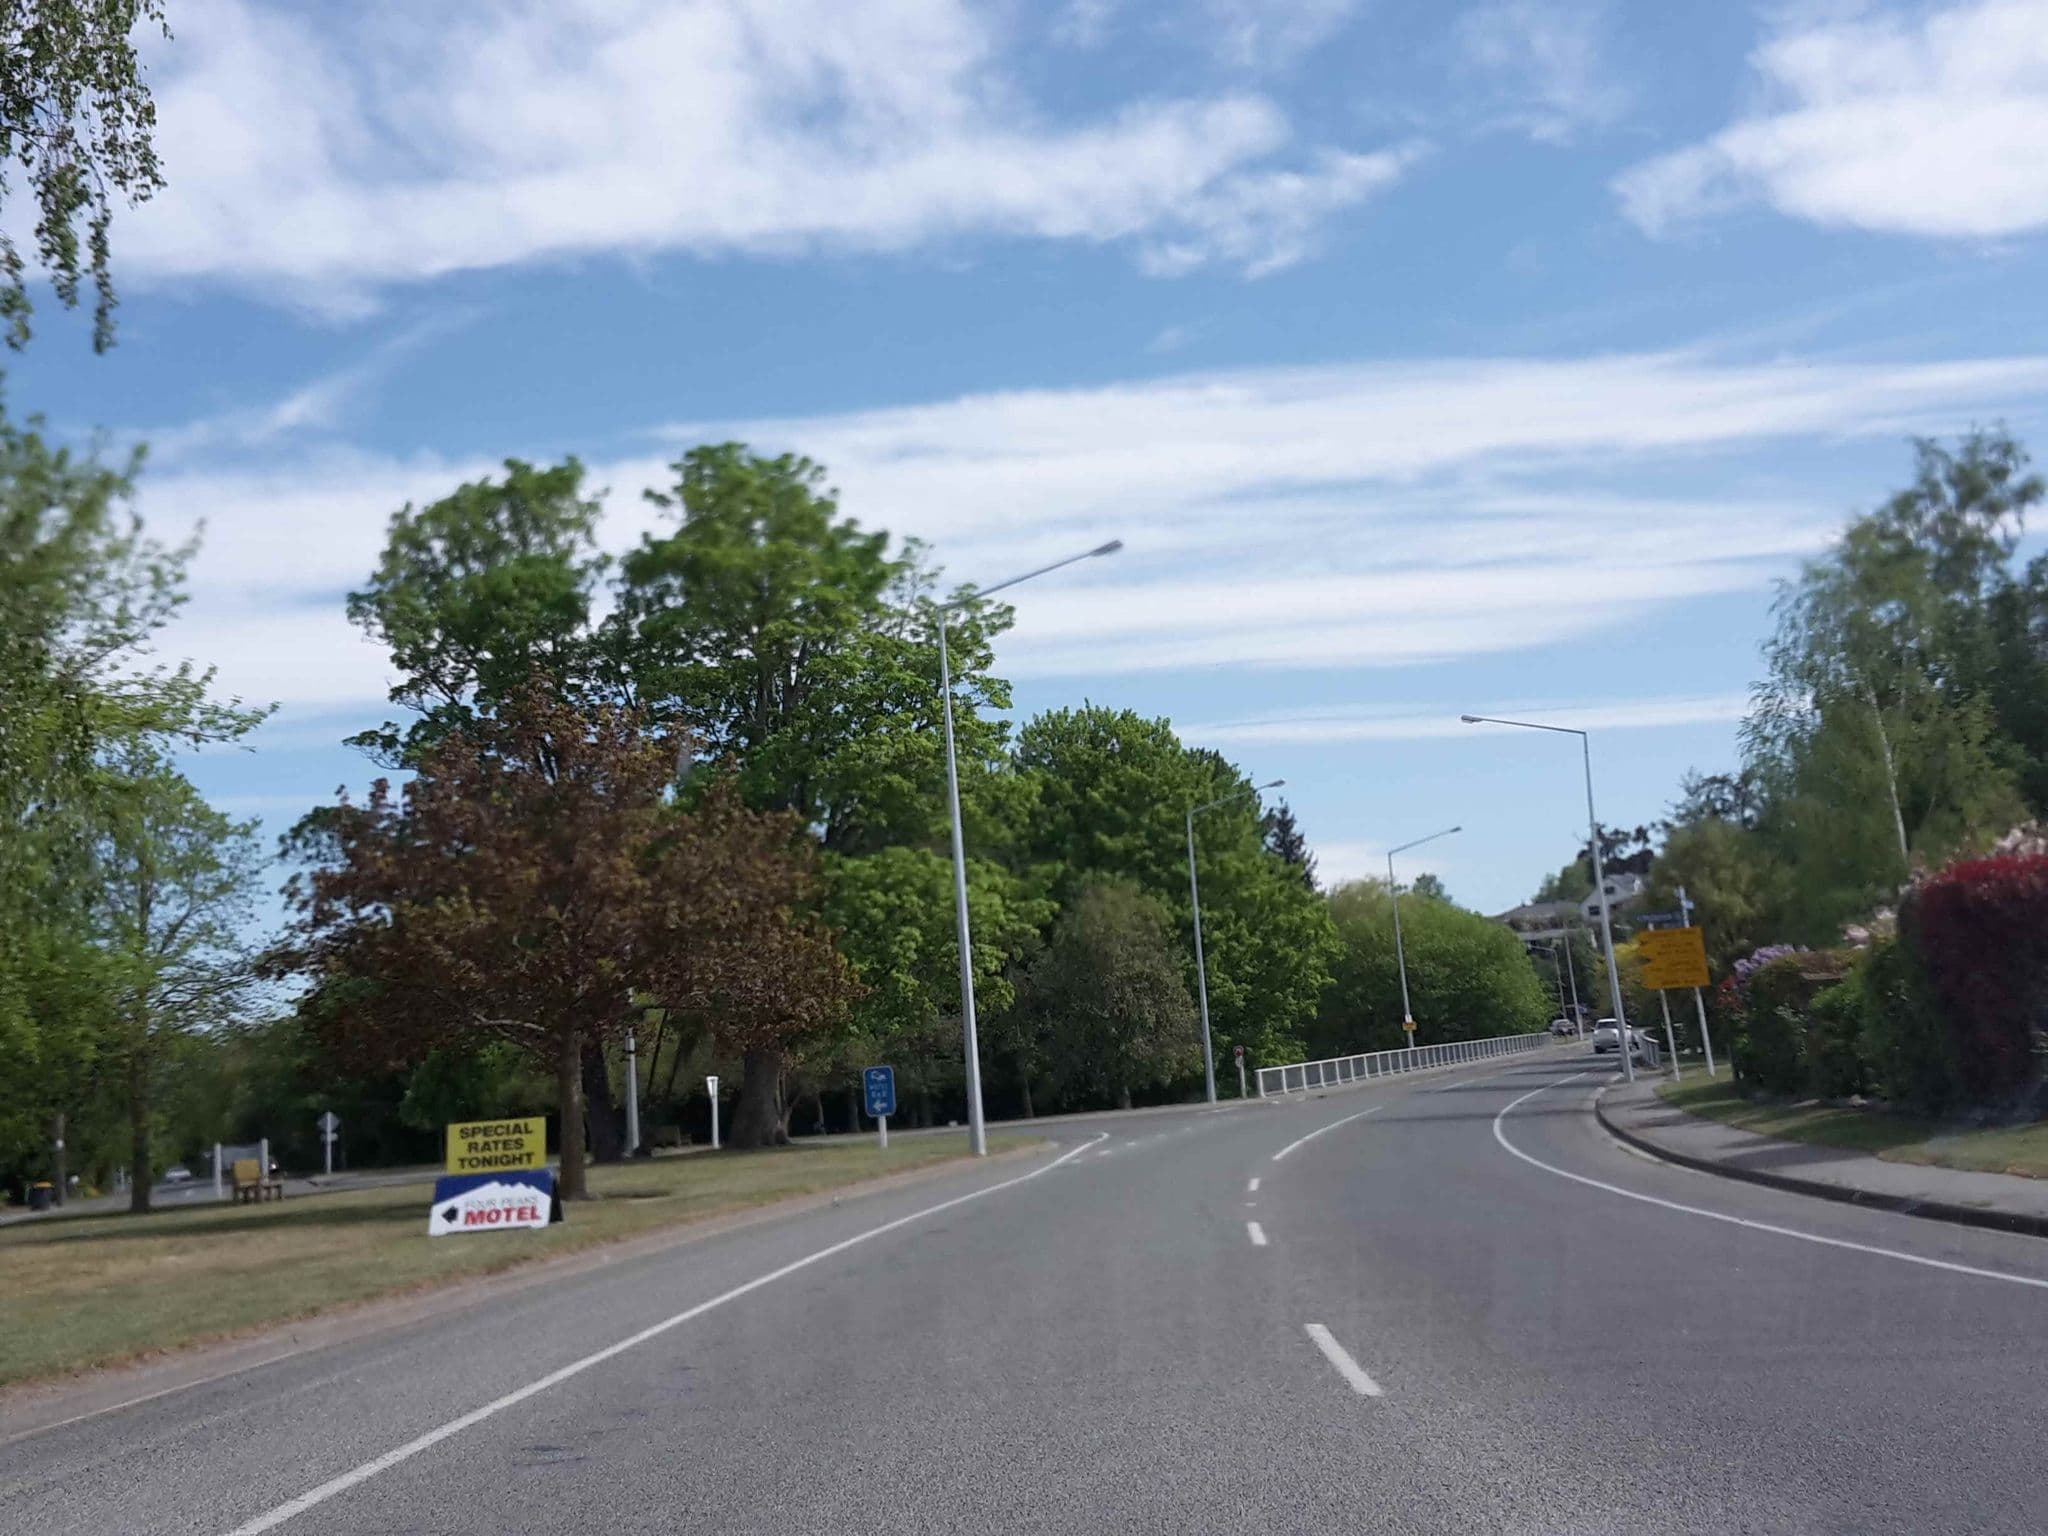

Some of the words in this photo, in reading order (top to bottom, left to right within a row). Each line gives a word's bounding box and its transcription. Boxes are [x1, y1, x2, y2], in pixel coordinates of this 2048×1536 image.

[460, 1122, 533, 1139] SPECIAL
[468, 1138, 524, 1153] RATES
[458, 1152, 535, 1169] TONIGHT
[465, 1206, 541, 1225] MOTEL
